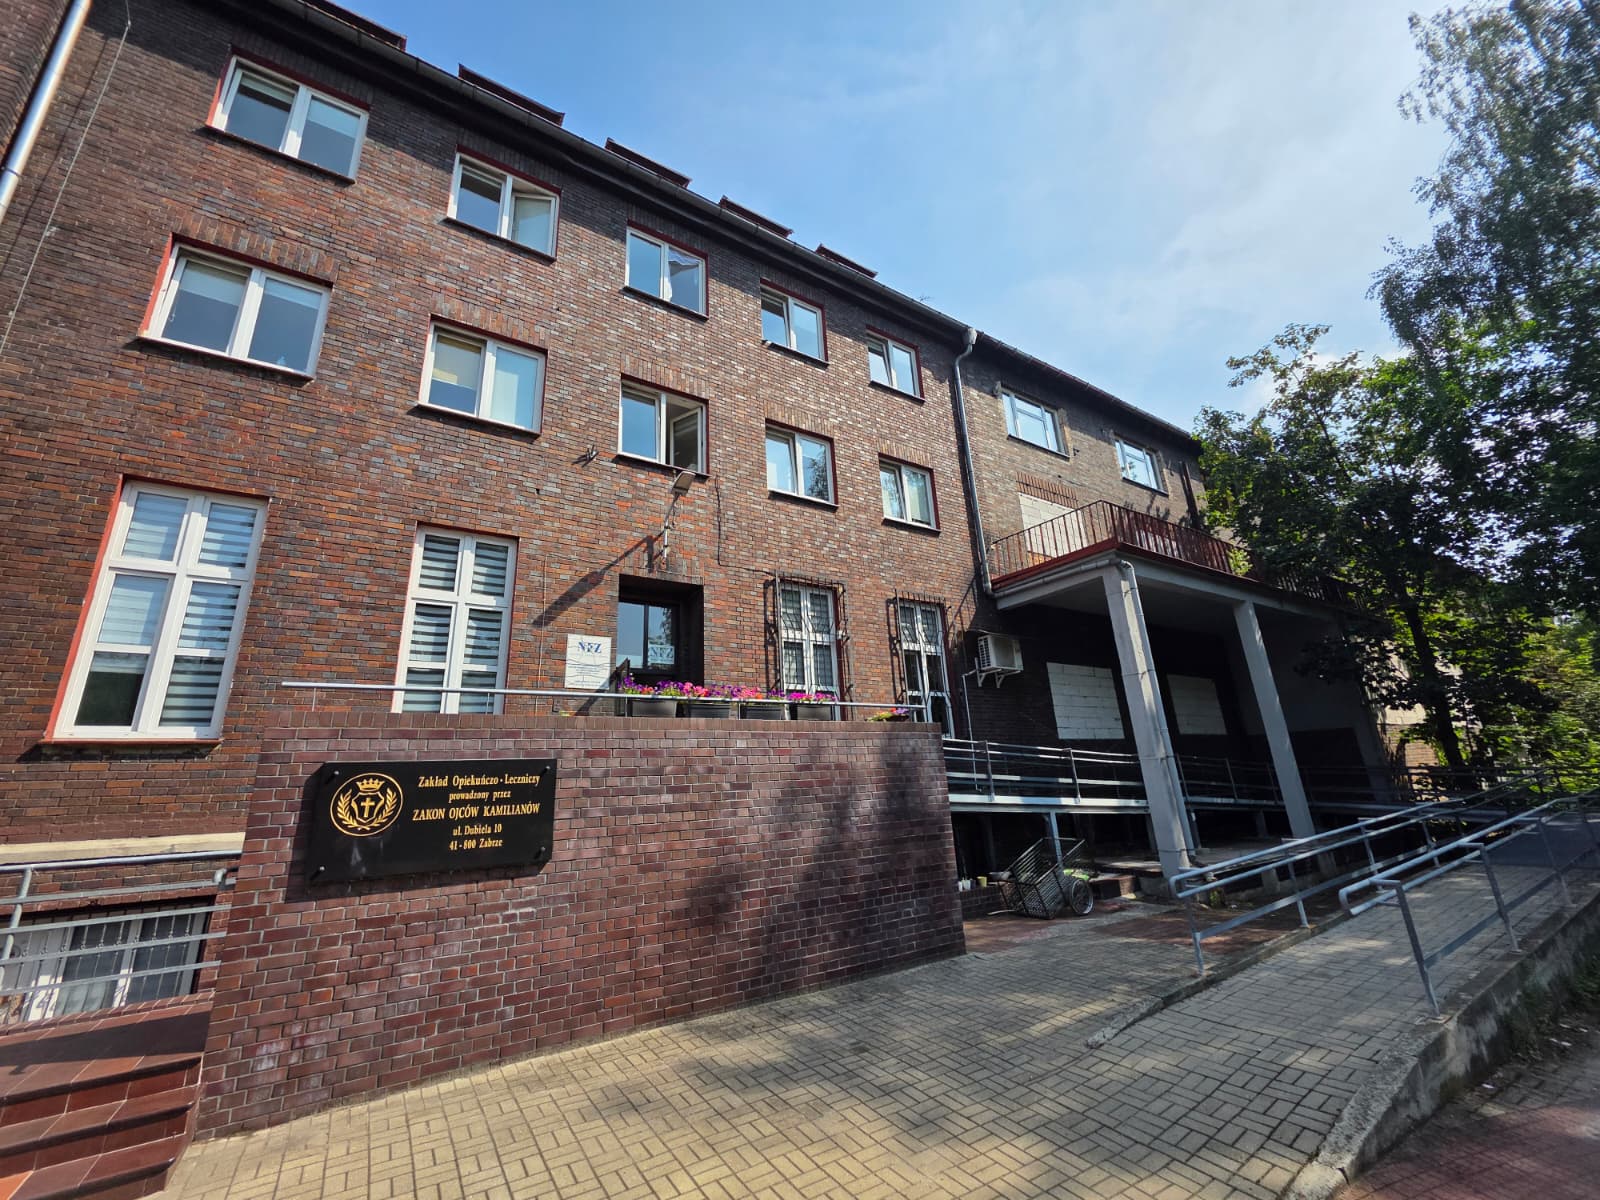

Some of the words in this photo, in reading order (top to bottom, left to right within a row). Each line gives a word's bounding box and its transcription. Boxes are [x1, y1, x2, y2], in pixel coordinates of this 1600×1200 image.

[578, 641, 602, 653] NFZ
[418, 775, 449, 788] Zakład
[448, 790, 490, 803] prowadzony
[492, 790, 512, 801] przez
[412, 808, 446, 821] ZAKON
[448, 804, 480, 821] OJCÓW
[483, 801, 541, 817] KAMILIANÓW
[453, 826, 462, 836] ul.
[464, 824, 492, 835] Dubiela
[494, 823, 503, 833] 10
[479, 837, 503, 849] Zabrze
